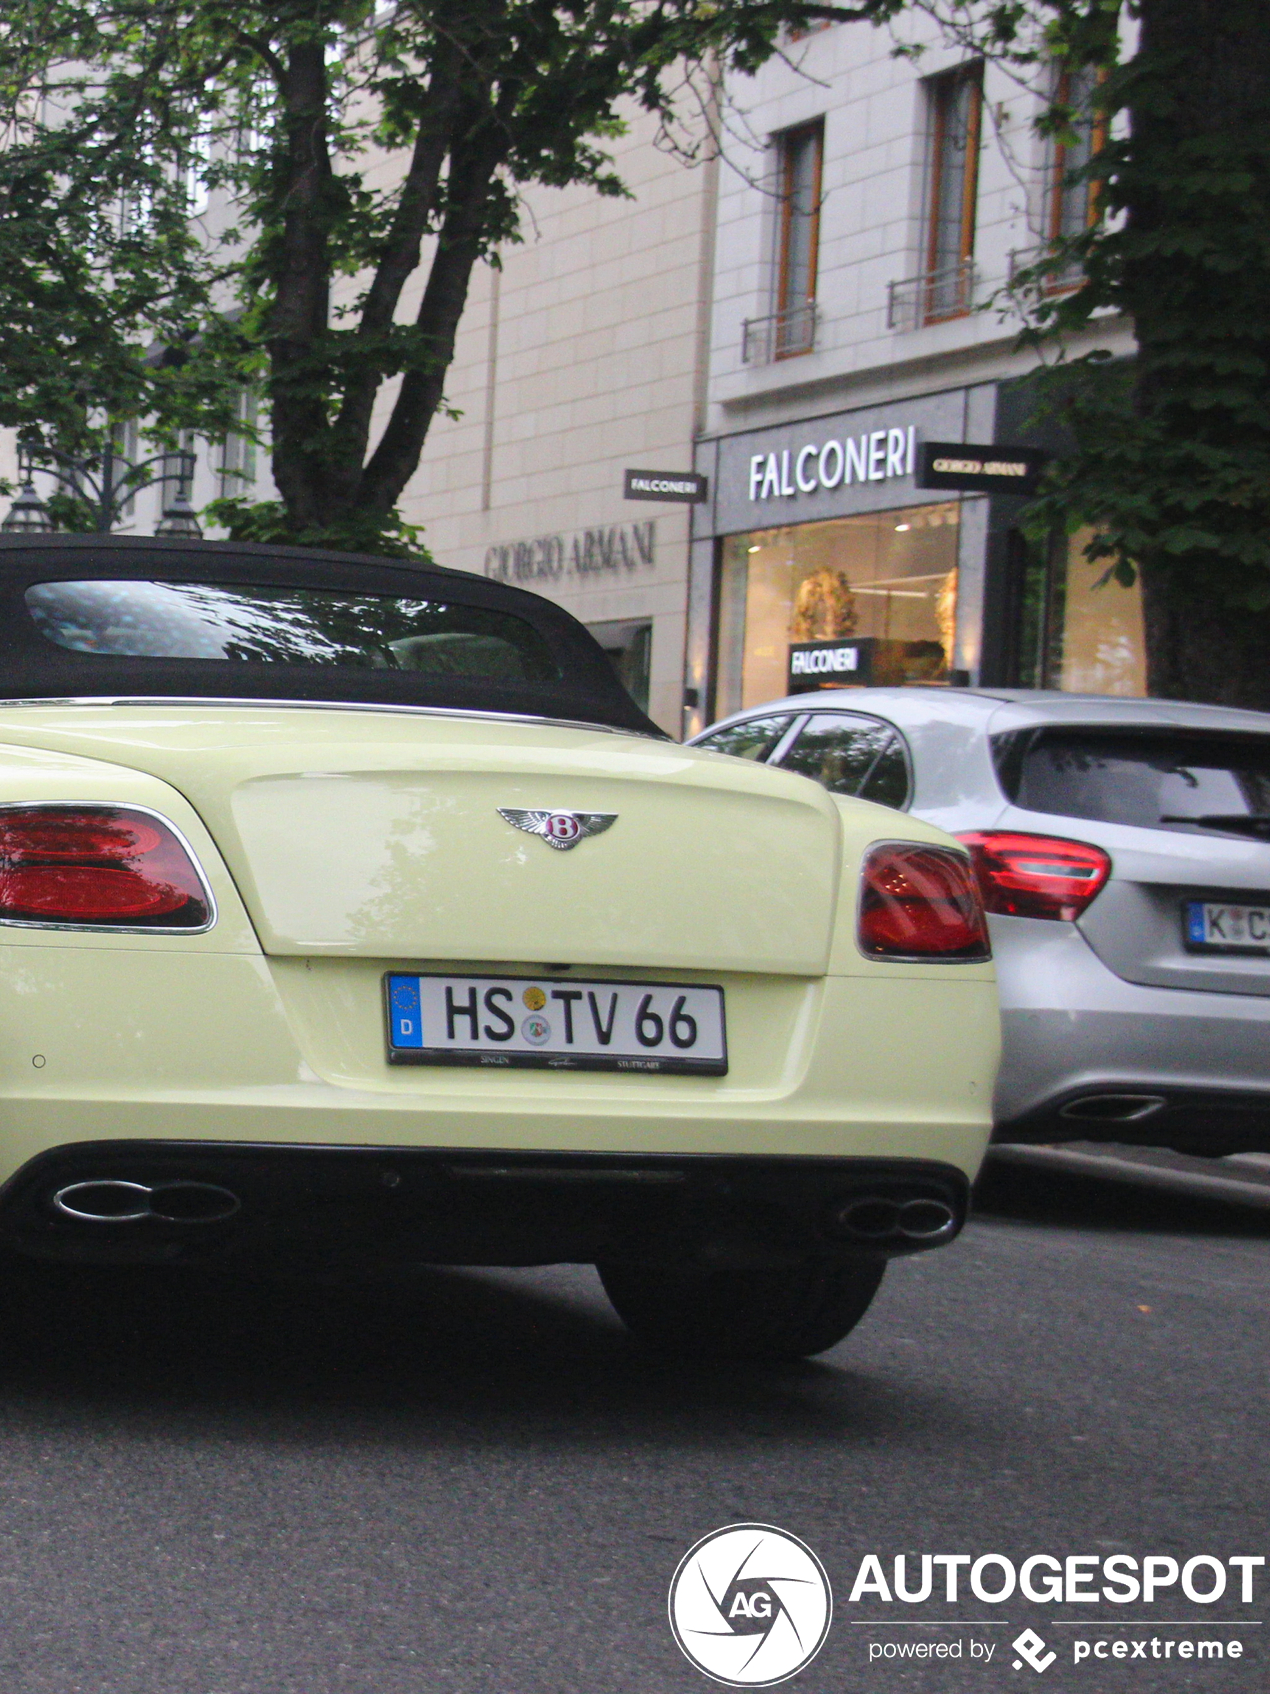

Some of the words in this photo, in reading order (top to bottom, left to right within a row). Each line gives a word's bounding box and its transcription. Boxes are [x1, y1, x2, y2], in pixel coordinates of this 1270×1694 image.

[748, 424, 916, 501] FALCONERI
[631, 478, 697, 494] FALCONERI
[566, 520, 656, 577] ARMANI
[791, 647, 858, 674] FALCONERI
[551, 816, 573, 838] B
[1207, 908, 1227, 939] K
[1248, 911, 1270, 941] C
[400, 1019, 413, 1035] D
[445, 986, 515, 1042] HS
[550, 990, 618, 1045] TV
[635, 993, 698, 1049] 66
[617, 1060, 660, 1069] STUTTGART
